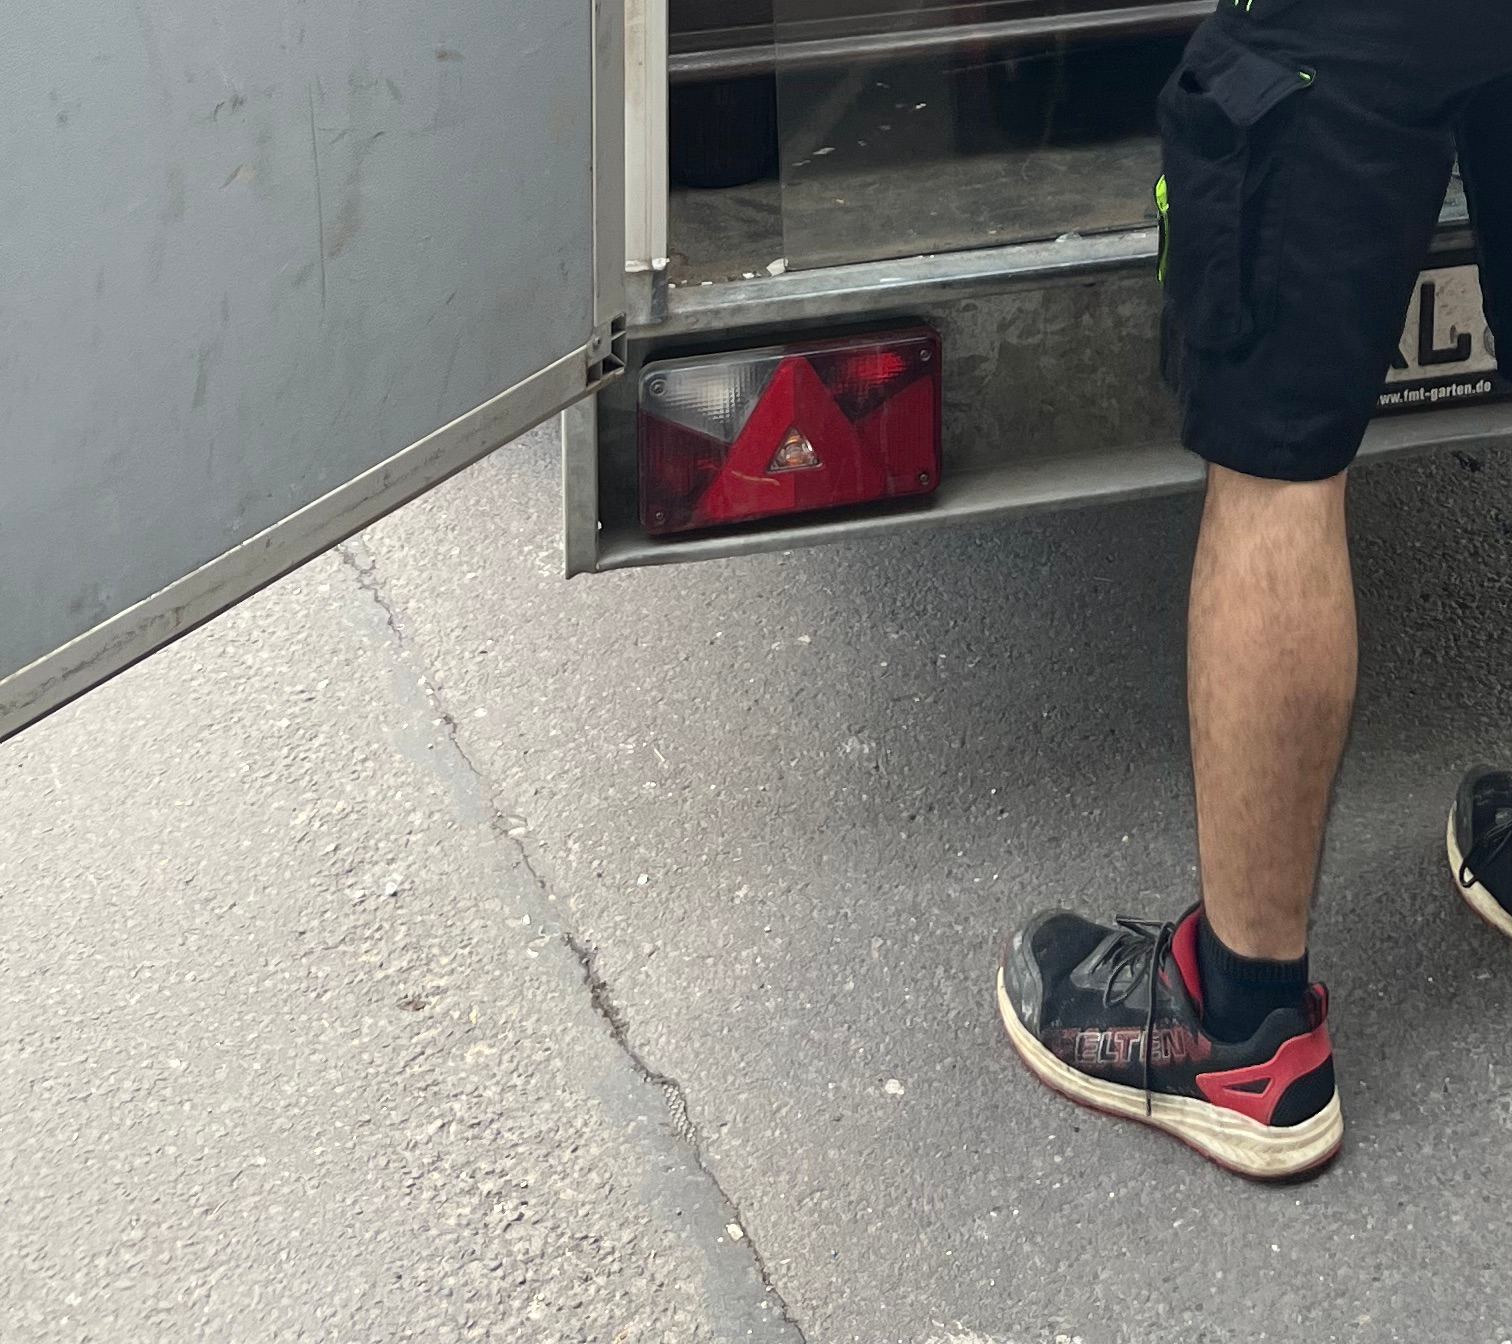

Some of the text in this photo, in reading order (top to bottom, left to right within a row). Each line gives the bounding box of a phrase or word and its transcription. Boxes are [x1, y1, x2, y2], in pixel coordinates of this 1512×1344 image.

[1391, 281, 1472, 369] L
[1376, 379, 1492, 406] ww.fmt-garten.de
[1074, 1027, 1187, 1064] ELTEN
